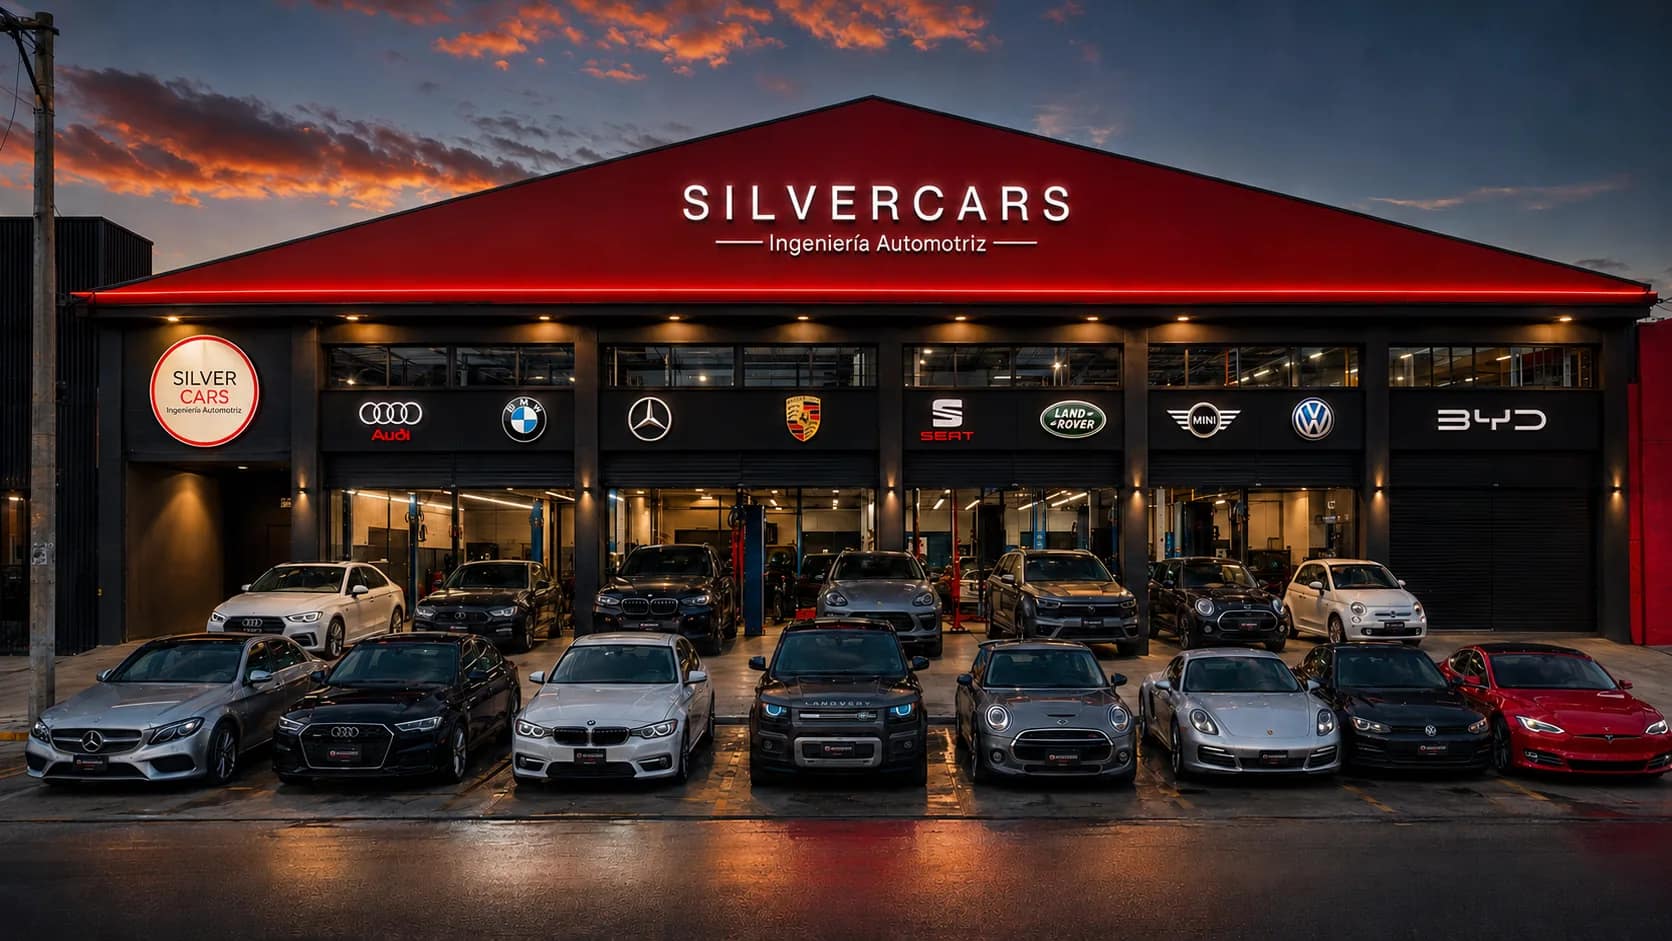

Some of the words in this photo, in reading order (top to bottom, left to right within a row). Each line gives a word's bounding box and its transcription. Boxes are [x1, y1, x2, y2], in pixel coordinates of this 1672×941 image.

[682, 184, 1070, 221] SILVERCARS
[769, 234, 870, 256] Ingeniería
[876, 234, 987, 252] Automotriz
[173, 370, 237, 386] SILVER
[180, 389, 230, 404] CARS
[506, 398, 542, 413] BMW
[1054, 408, 1085, 418] LAND
[1057, 419, 1095, 430] ROVER
[1193, 416, 1216, 425] MINI
[1438, 409, 1547, 430] BYD
[371, 428, 411, 441] Audi
[920, 431, 974, 441] SEAT
